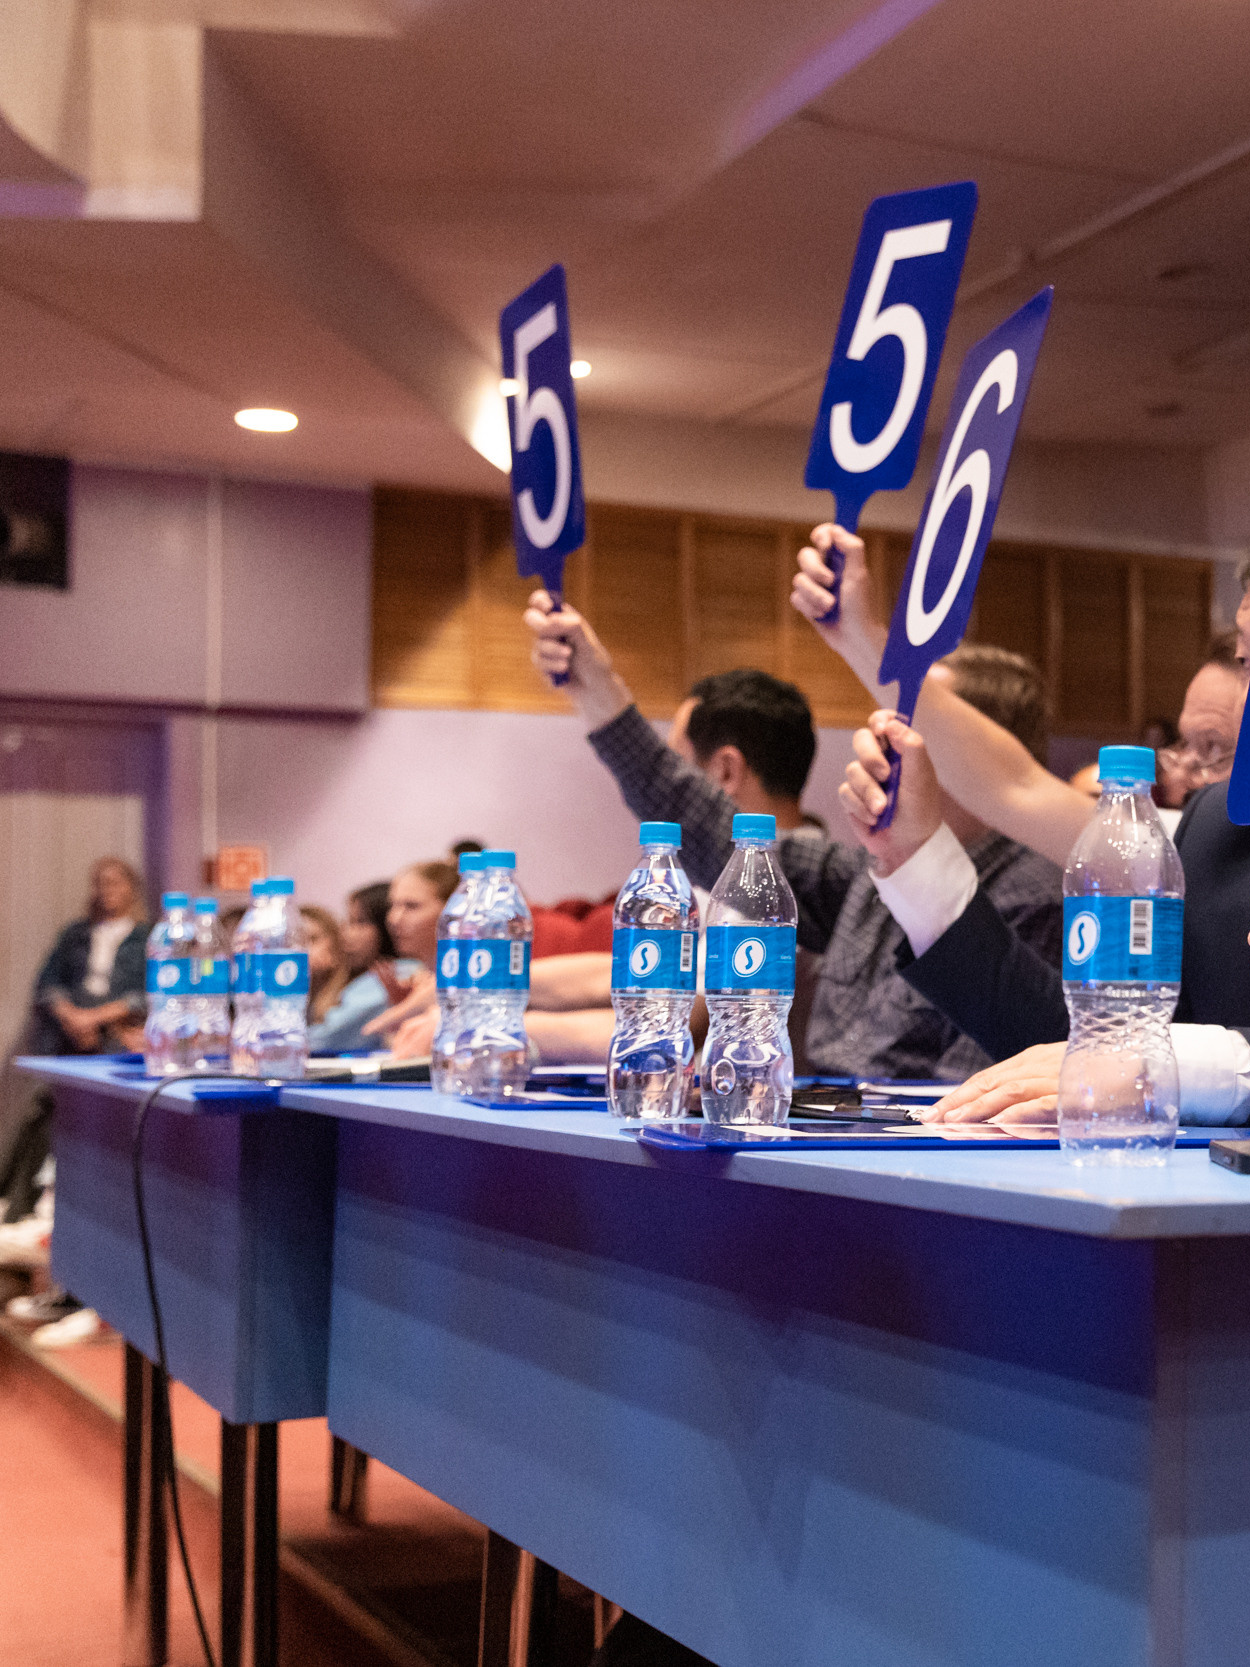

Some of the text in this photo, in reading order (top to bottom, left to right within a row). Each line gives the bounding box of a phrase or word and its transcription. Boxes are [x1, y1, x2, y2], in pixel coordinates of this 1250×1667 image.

[514, 301, 572, 549] 5
[830, 219, 952, 473] 5
[905, 348, 1018, 647] 6
